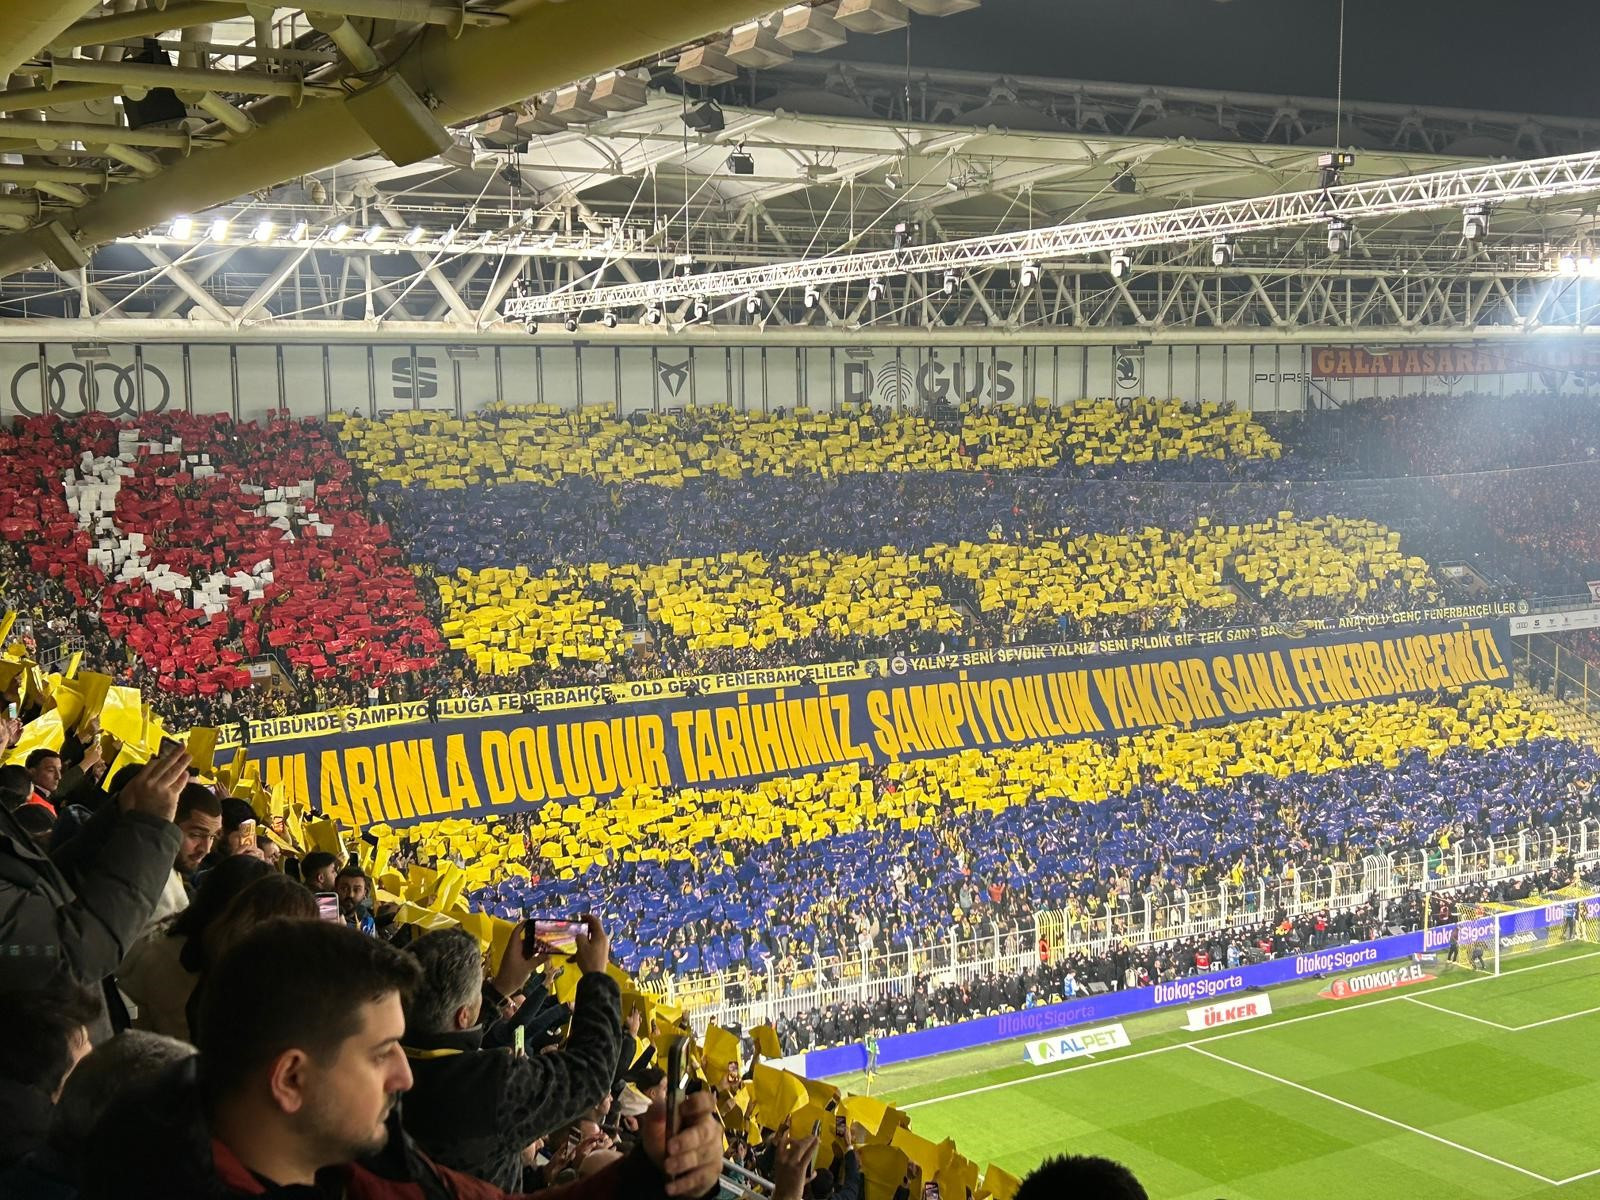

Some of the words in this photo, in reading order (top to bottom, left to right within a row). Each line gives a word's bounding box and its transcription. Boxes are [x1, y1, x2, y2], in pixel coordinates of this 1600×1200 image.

[1317, 349, 1506, 374] GALATASARAY
[1392, 610, 1422, 624] GENÇ
[1049, 641, 1097, 657] YALNIZ
[1099, 637, 1129, 652] SENİ
[1199, 630, 1224, 644] TEK
[250, 714, 341, 738] TRİBÜNDE
[630, 682, 663, 697] OLD
[481, 714, 671, 806] DOLUDUR
[672, 684, 875, 783] TARİHİMİZ,
[866, 669, 1106, 764] ŞAMPİYONLUK
[1092, 658, 1225, 732] YAKIŞIR
[1212, 650, 1303, 714] SANA
[1292, 621, 1509, 705] FENERBAHÇEMİZ!
[1295, 954, 1334, 974] Otokoç
[1334, 948, 1377, 968] Sigorta
[1154, 982, 1196, 1004] Otokoç
[1196, 975, 1243, 996] Sigorta
[1349, 969, 1399, 992] OTOKOÇ
[999, 1014, 1044, 1035] Otokoç
[1044, 1005, 1095, 1027] Sigorta
[1204, 1002, 1258, 1026] ÜLKER
[1060, 1029, 1117, 1055] ALPET
